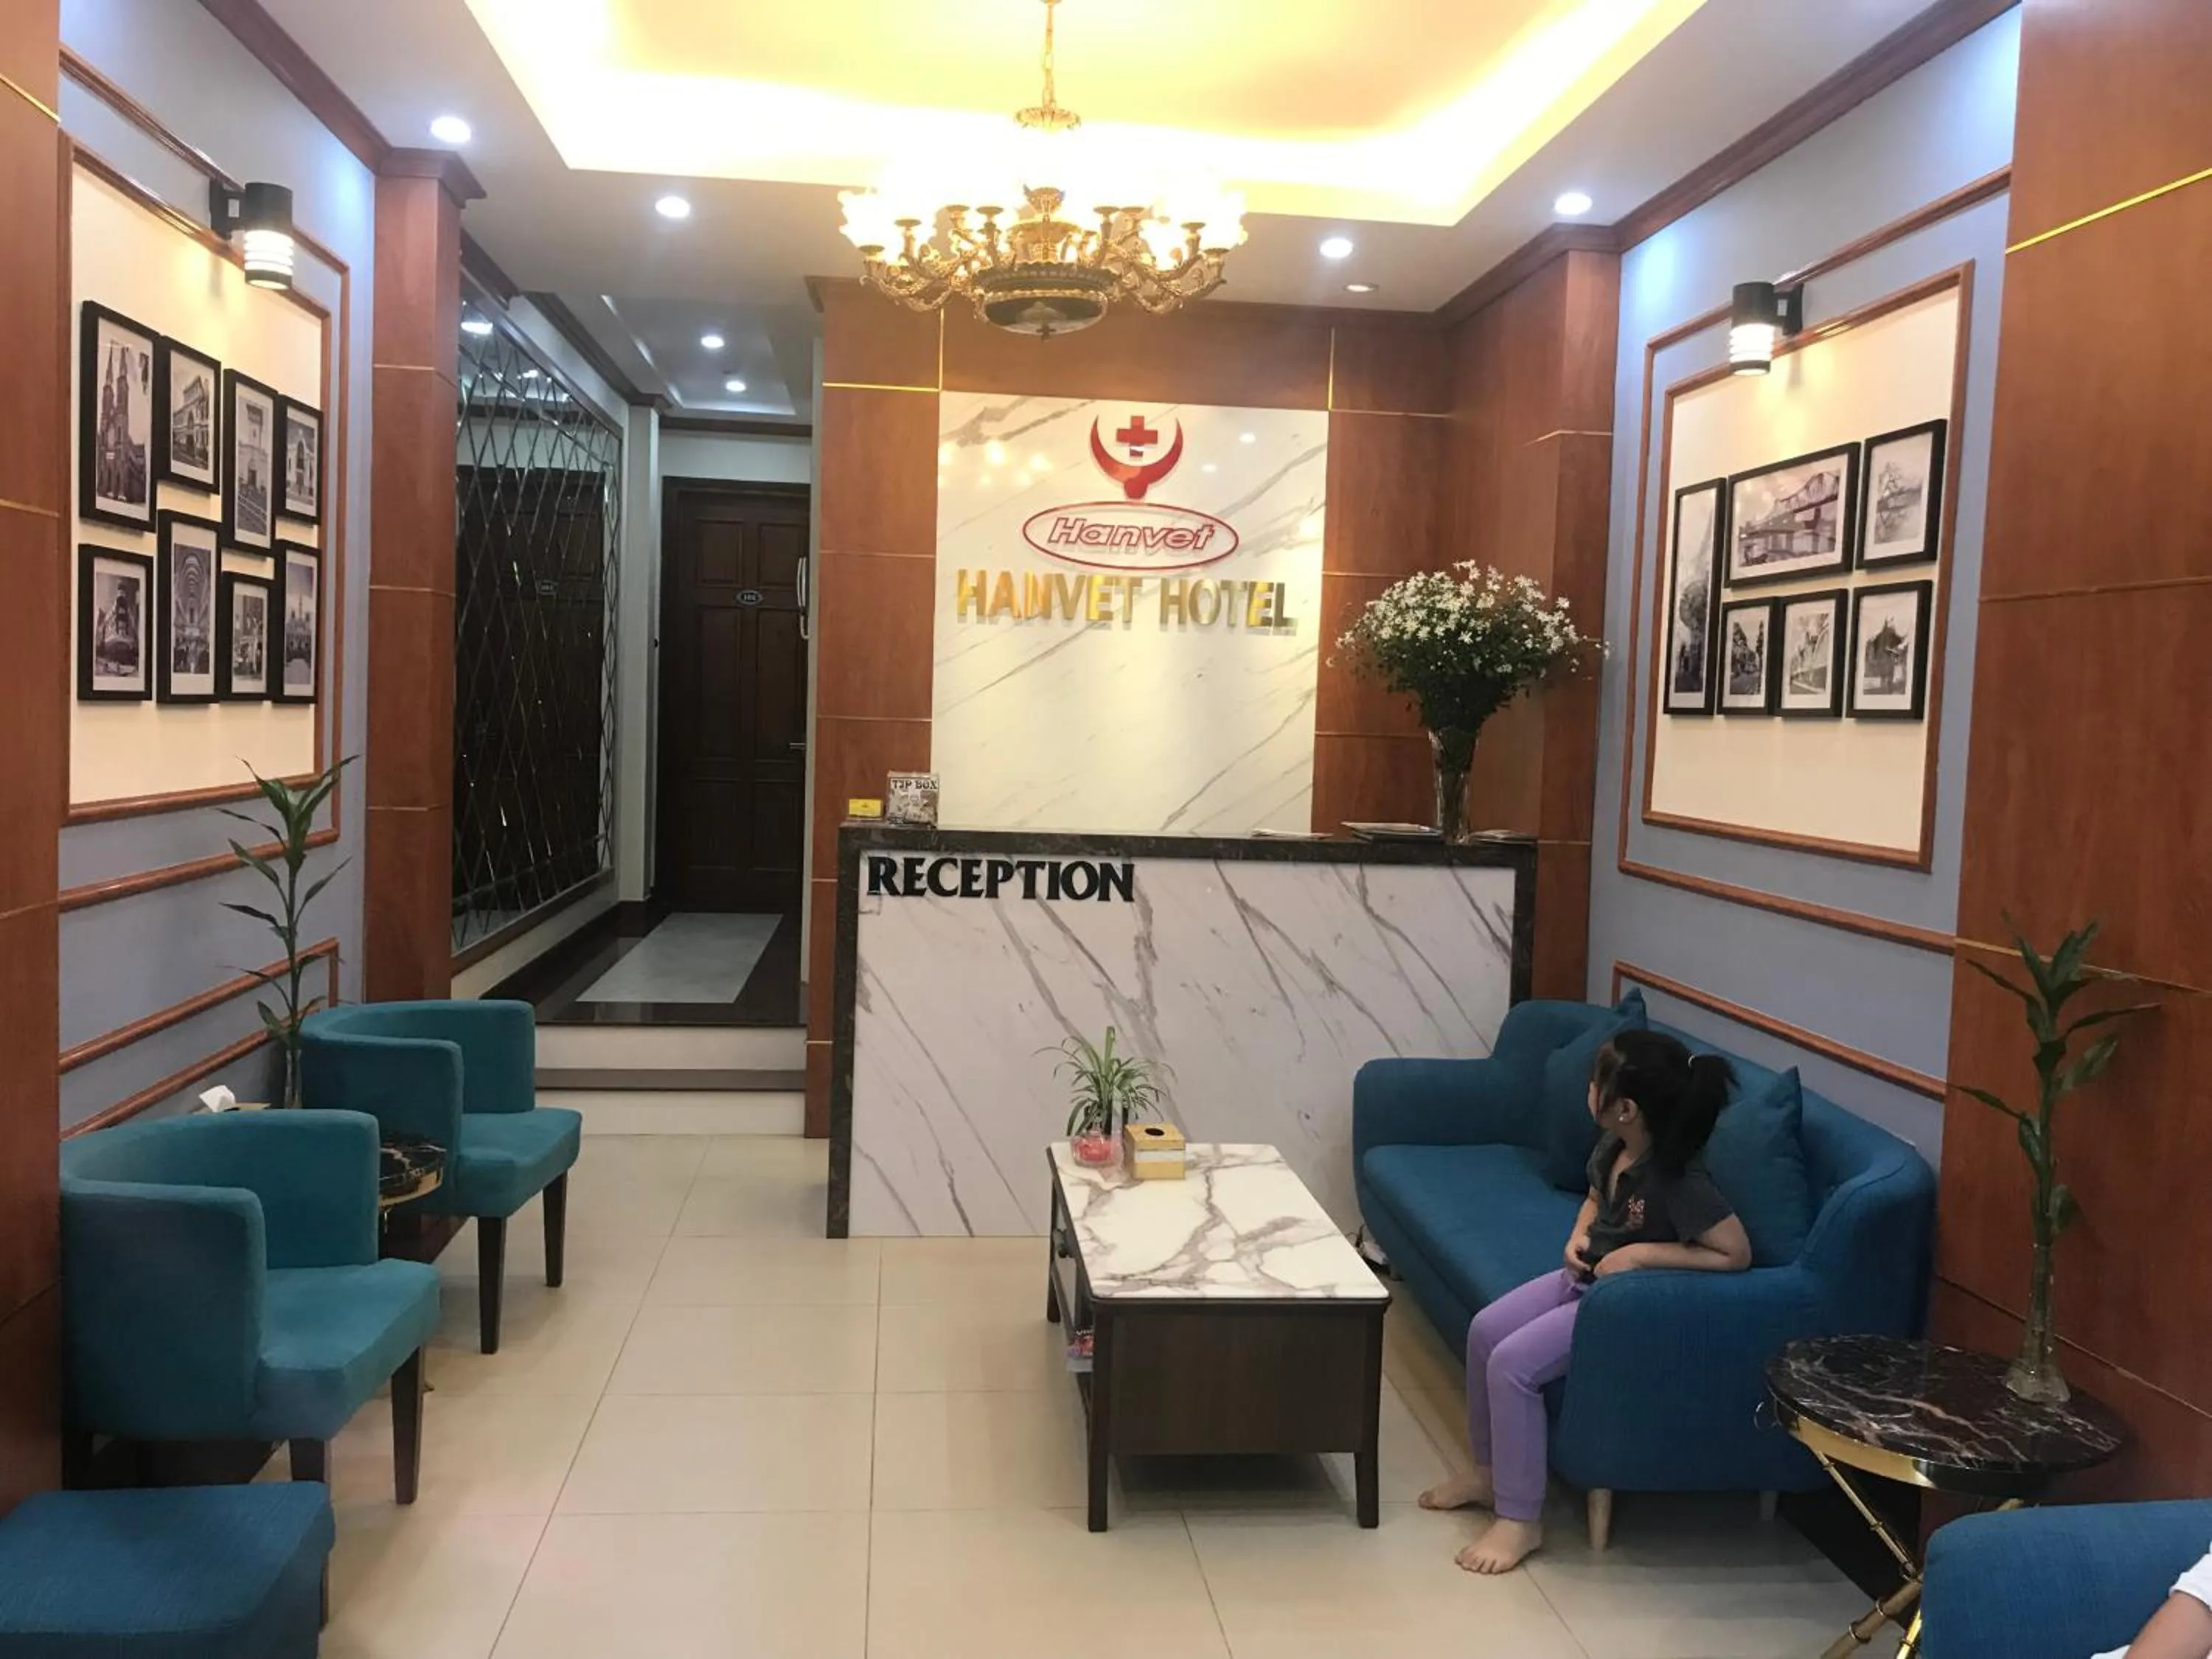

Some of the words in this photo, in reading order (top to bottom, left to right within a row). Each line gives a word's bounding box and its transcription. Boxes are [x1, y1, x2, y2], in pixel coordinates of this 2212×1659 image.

[1048, 518, 1215, 551] Hanvet
[958, 569, 1141, 622] HANVET
[1160, 577, 1297, 628] HOTEL
[915, 780, 938, 790] BOX
[866, 856, 1134, 902] RECEPTION
